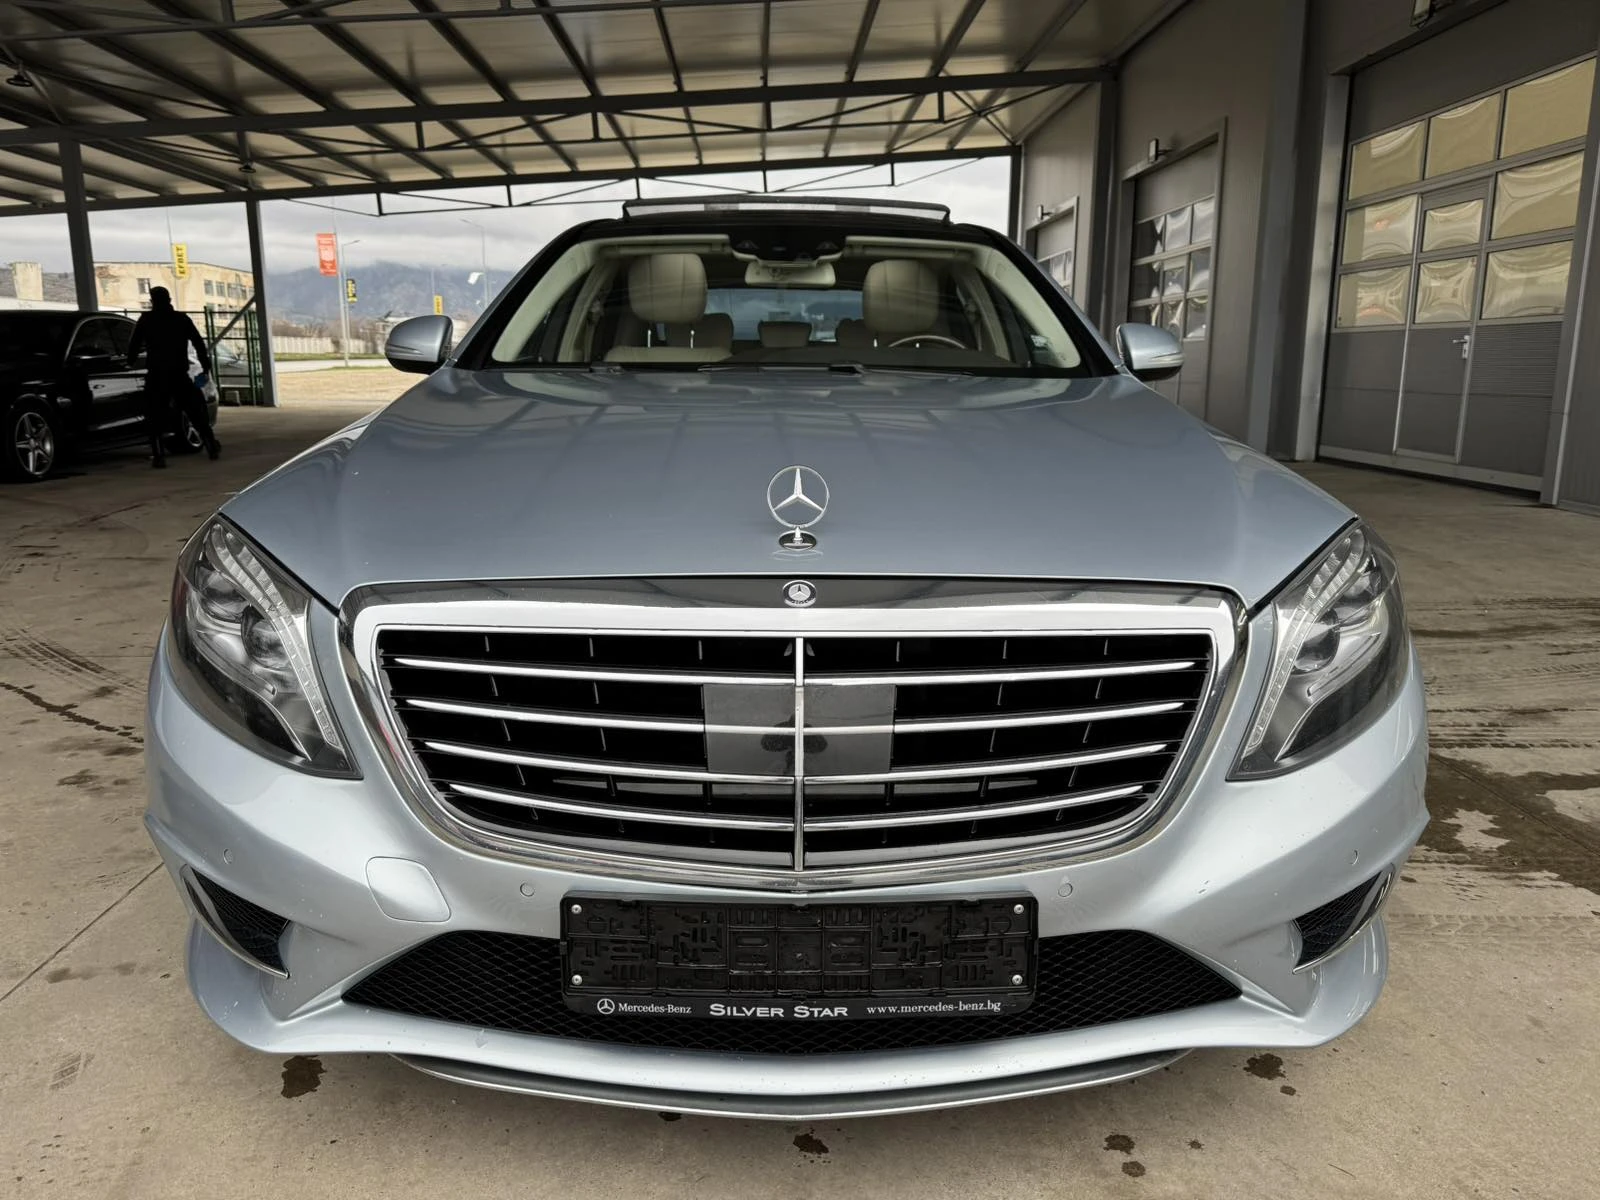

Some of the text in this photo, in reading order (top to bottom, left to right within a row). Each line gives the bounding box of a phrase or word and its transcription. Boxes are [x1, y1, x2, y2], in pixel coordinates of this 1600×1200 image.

[618, 1003, 692, 1015] Mercedes-Benz
[709, 1003, 849, 1018] SILVER STAR
[867, 1000, 1001, 1015] www.mercedes-benz.bg
